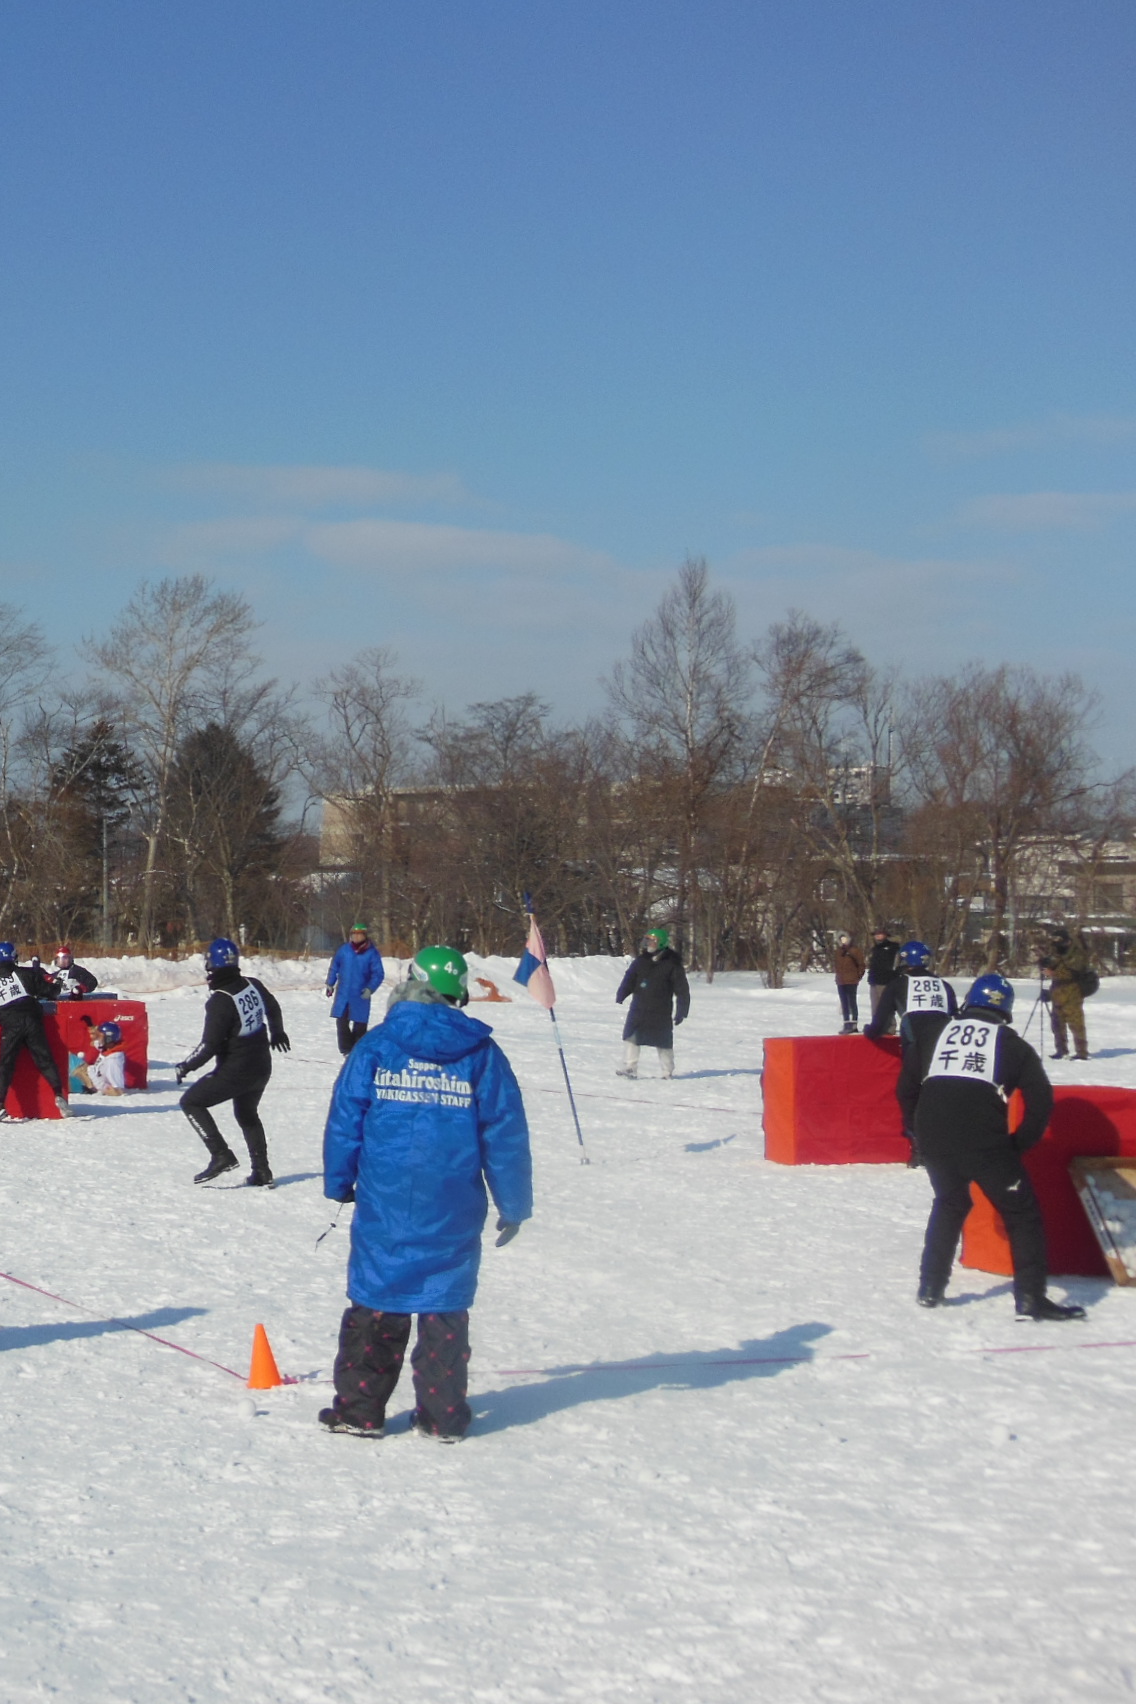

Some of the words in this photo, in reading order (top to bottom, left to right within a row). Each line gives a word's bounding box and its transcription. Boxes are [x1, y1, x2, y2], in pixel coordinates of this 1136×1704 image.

[913, 980, 940, 992] 285
[238, 990, 259, 1015] 286
[912, 994, 944, 1008] 千歳
[946, 1025, 990, 1047] 283
[938, 1050, 987, 1073] 千歳
[440, 1094, 471, 1108] STAFF
